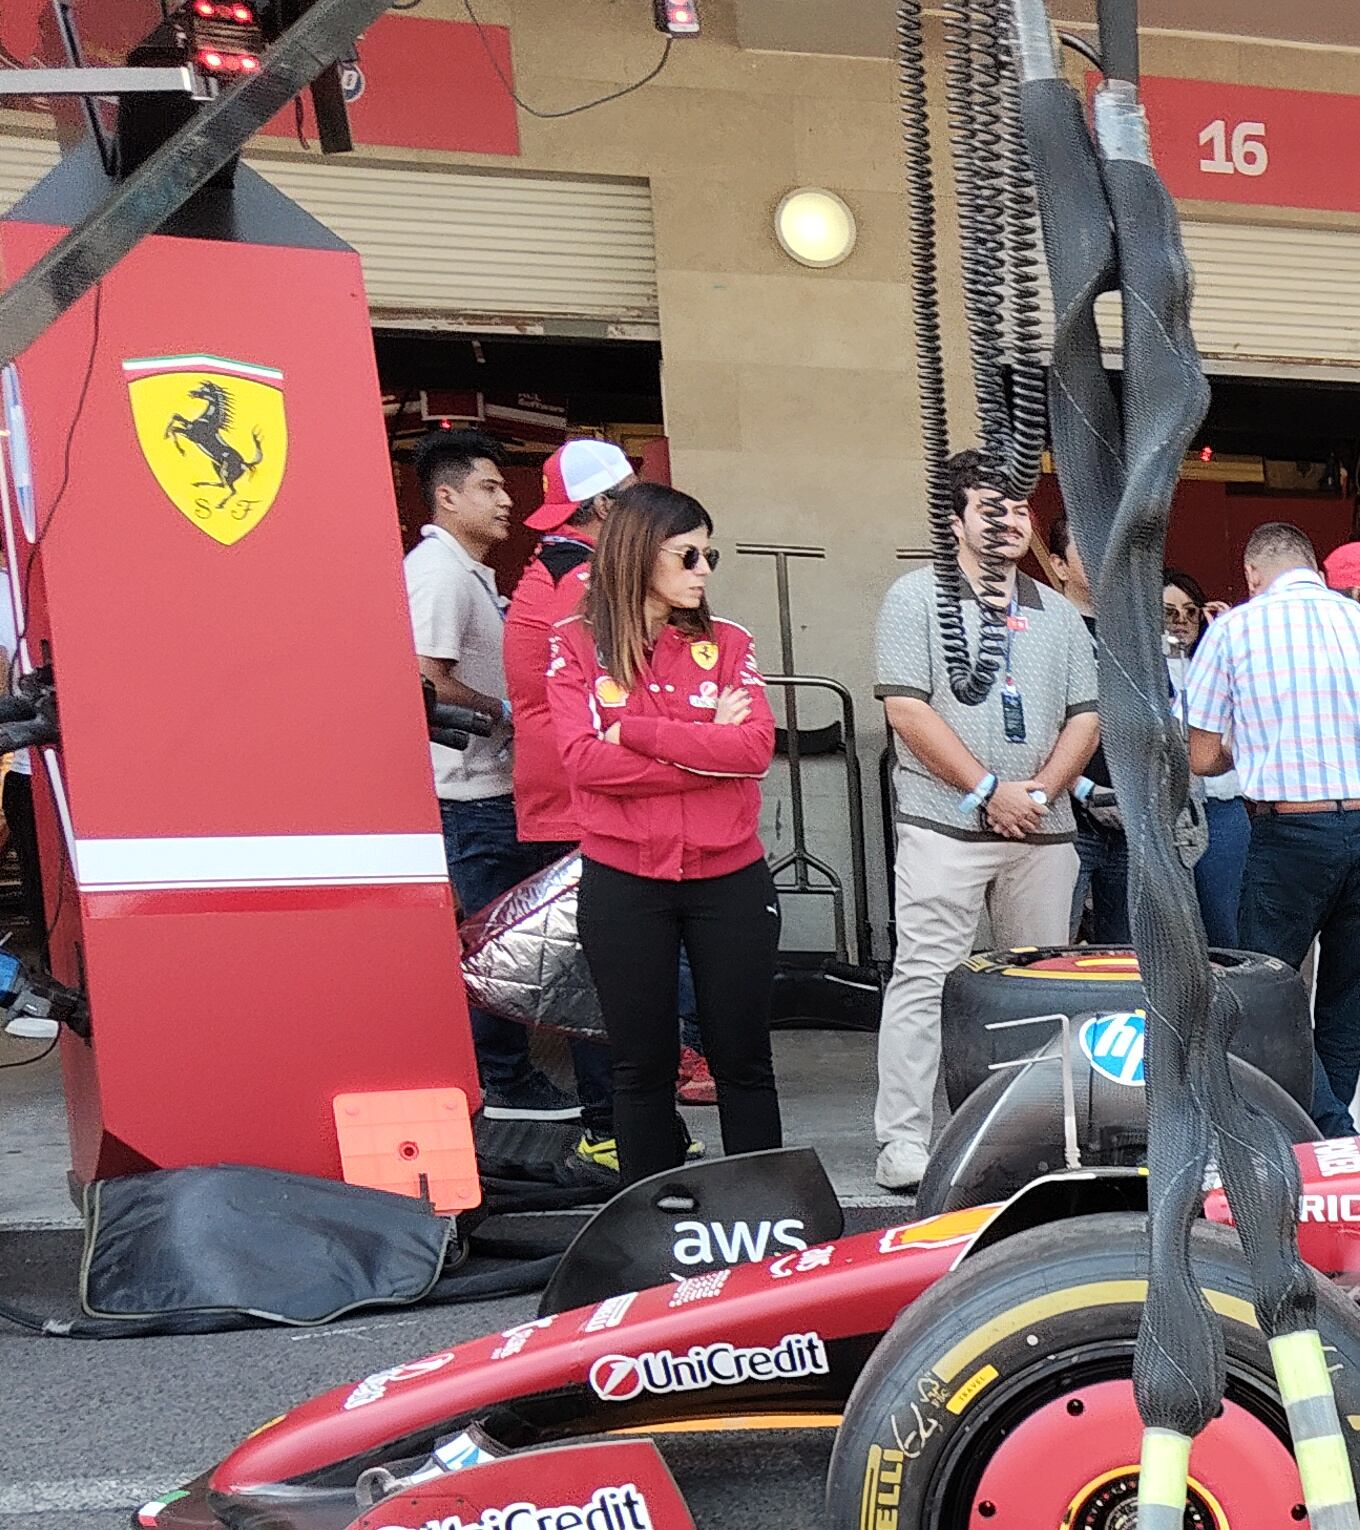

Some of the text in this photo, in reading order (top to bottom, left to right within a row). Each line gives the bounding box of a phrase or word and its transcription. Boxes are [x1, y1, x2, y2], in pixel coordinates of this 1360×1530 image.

[1198, 119, 1269, 176] 16
[673, 1218, 809, 1266] aws
[643, 1335, 826, 1390] UniCredit
